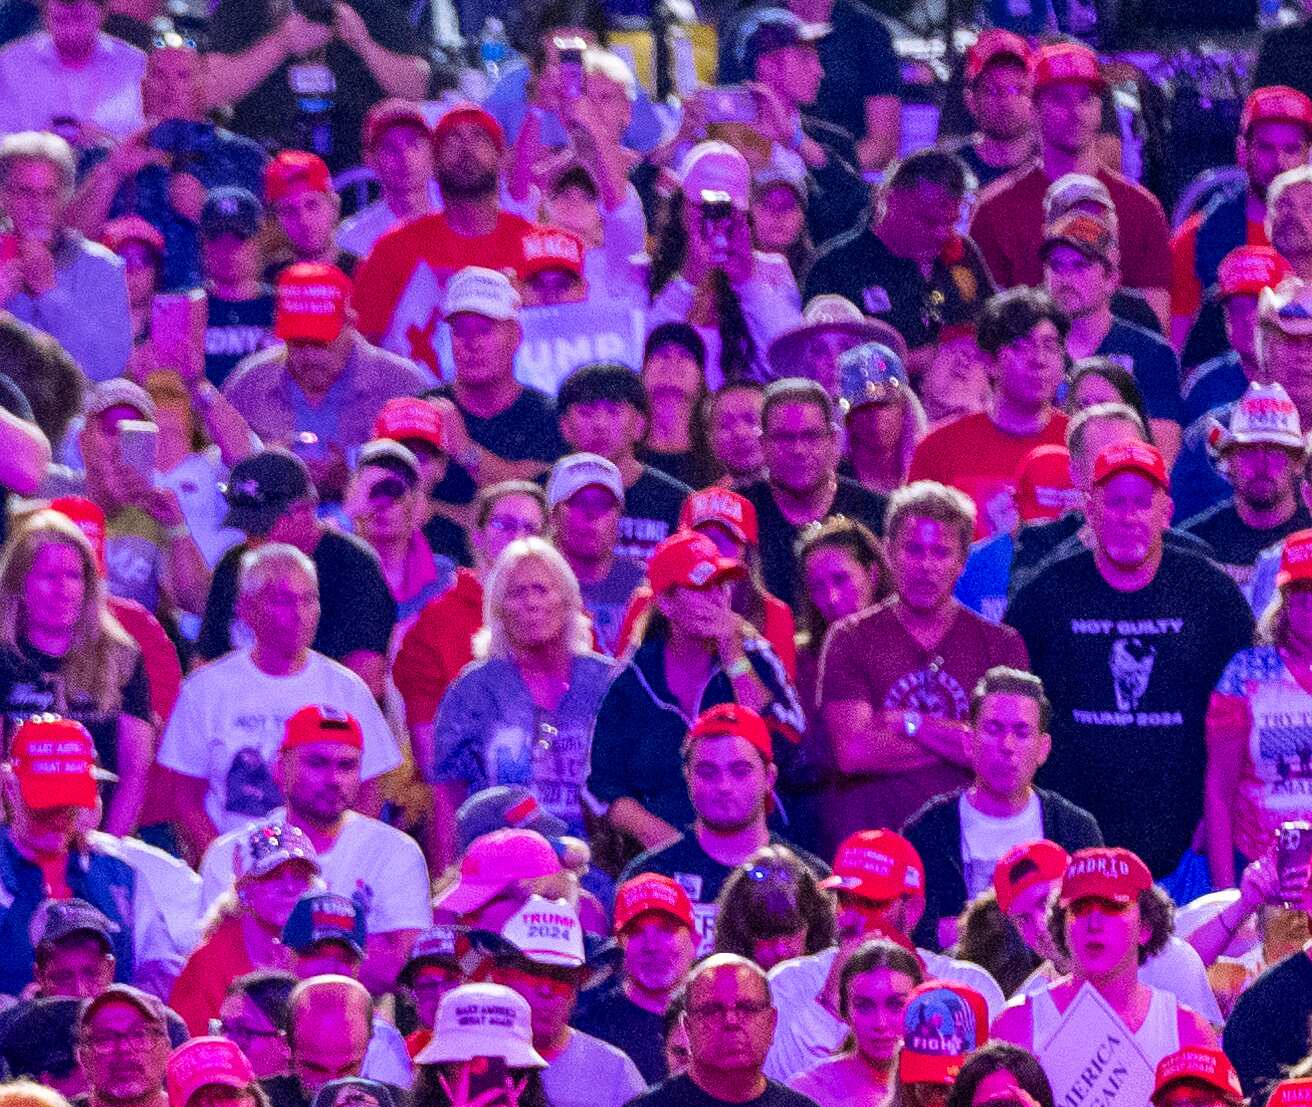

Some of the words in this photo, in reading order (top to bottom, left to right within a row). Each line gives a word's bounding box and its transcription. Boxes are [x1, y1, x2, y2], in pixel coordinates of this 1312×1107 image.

[1072, 618, 1114, 636] NOT
[1118, 618, 1183, 635] GUILTY
[1066, 851, 1131, 878] MADRID
[521, 913, 576, 930] TRUMP
[527, 926, 571, 941] 2024
[911, 1035, 965, 1054] FIGHT
[1280, 1086, 1312, 1103] MAKE
